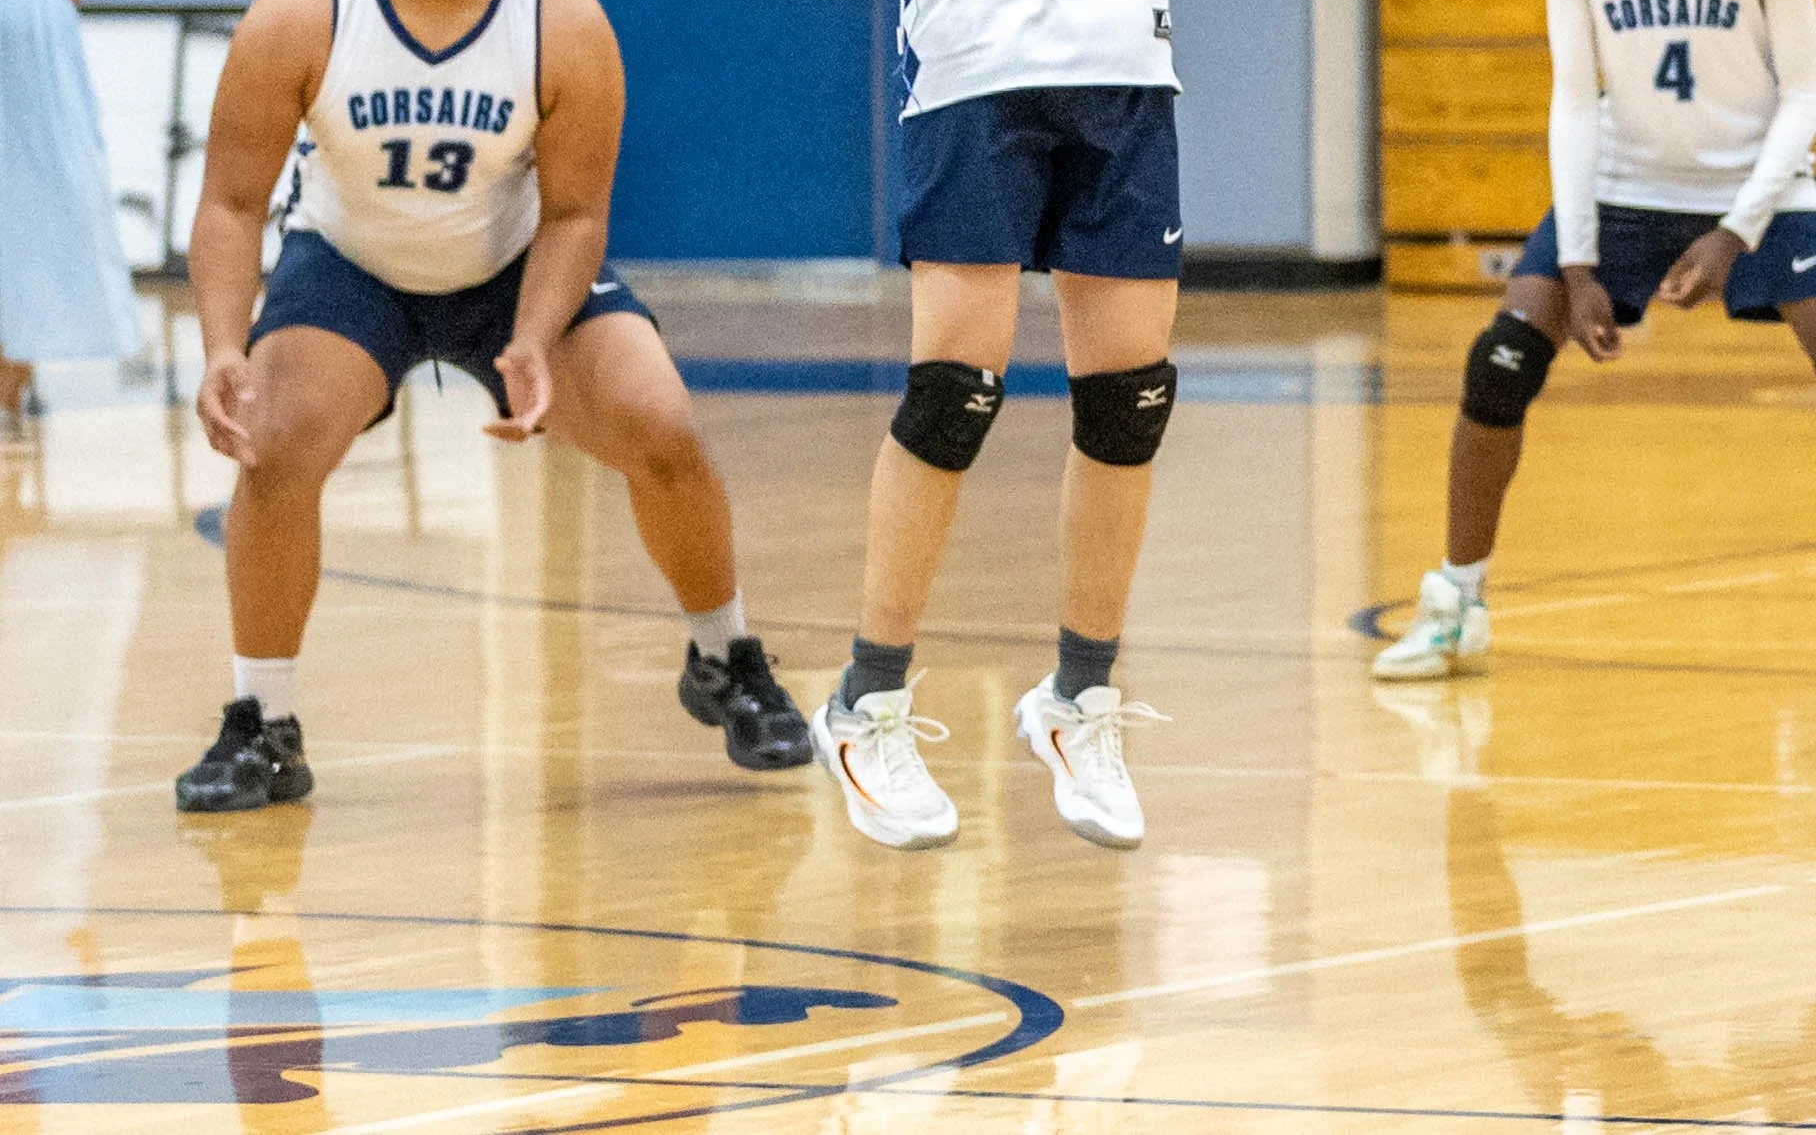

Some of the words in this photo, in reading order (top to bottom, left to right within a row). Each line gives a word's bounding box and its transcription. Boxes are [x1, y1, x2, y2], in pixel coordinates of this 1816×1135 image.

[1655, 41, 1695, 101] 4
[348, 87, 514, 135] CORSAIRS
[377, 139, 475, 192] 13
